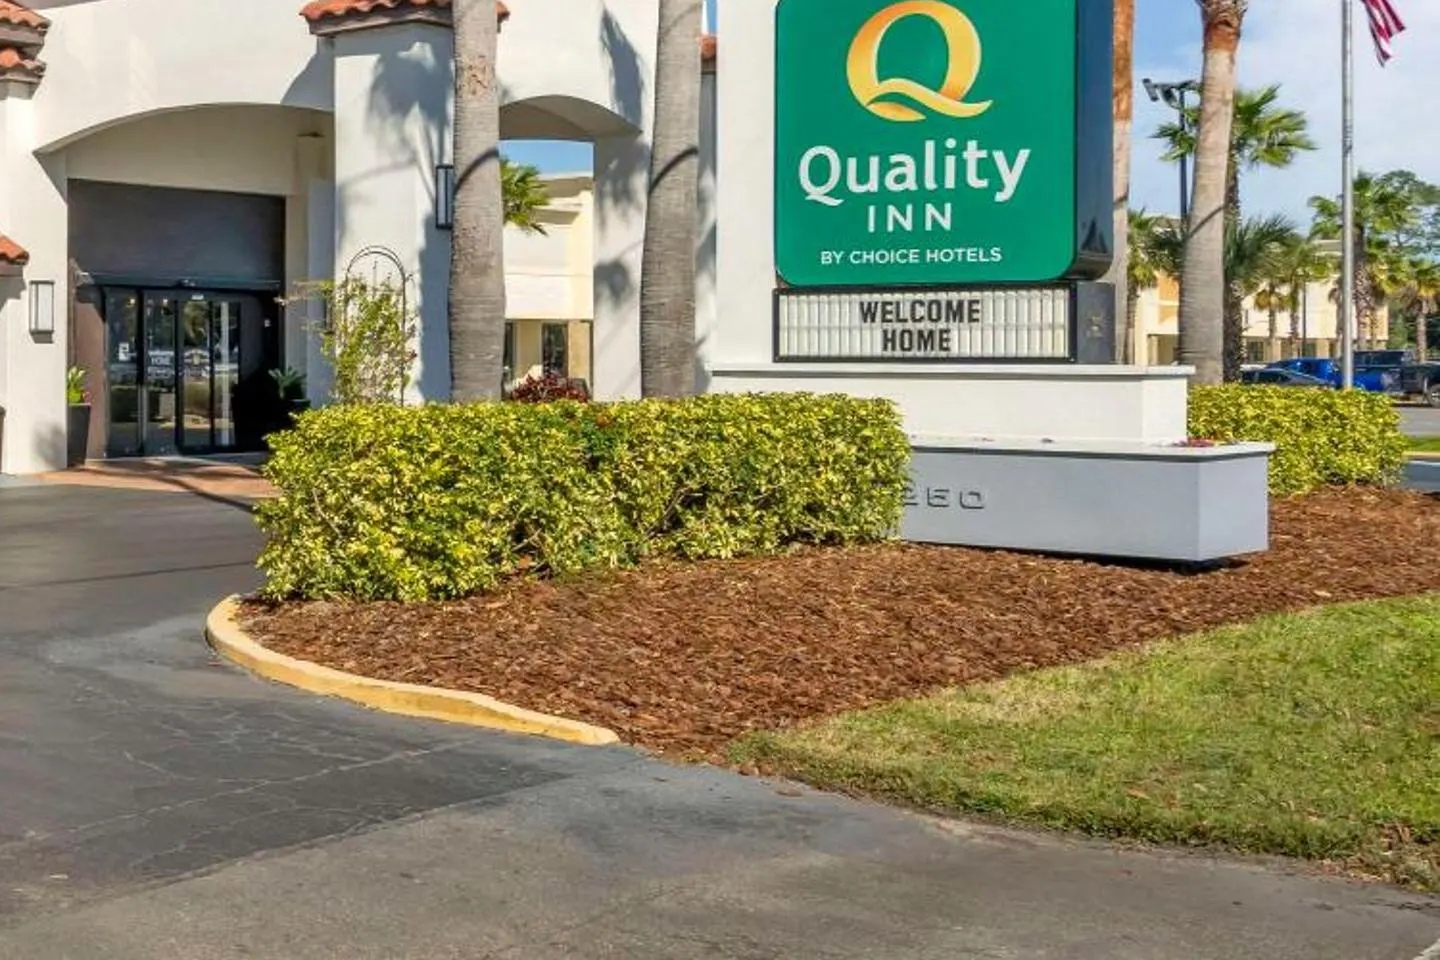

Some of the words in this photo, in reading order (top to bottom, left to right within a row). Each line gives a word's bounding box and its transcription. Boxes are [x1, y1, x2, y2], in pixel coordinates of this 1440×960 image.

[846, 0, 993, 122] Q
[799, 138, 1031, 206] Quality
[868, 202, 953, 233] INN
[821, 251, 844, 265] BY
[849, 249, 921, 265] CHOICE
[926, 247, 1002, 263] HOTELS
[859, 299, 981, 324] WELCOME
[882, 327, 952, 353] HOME
